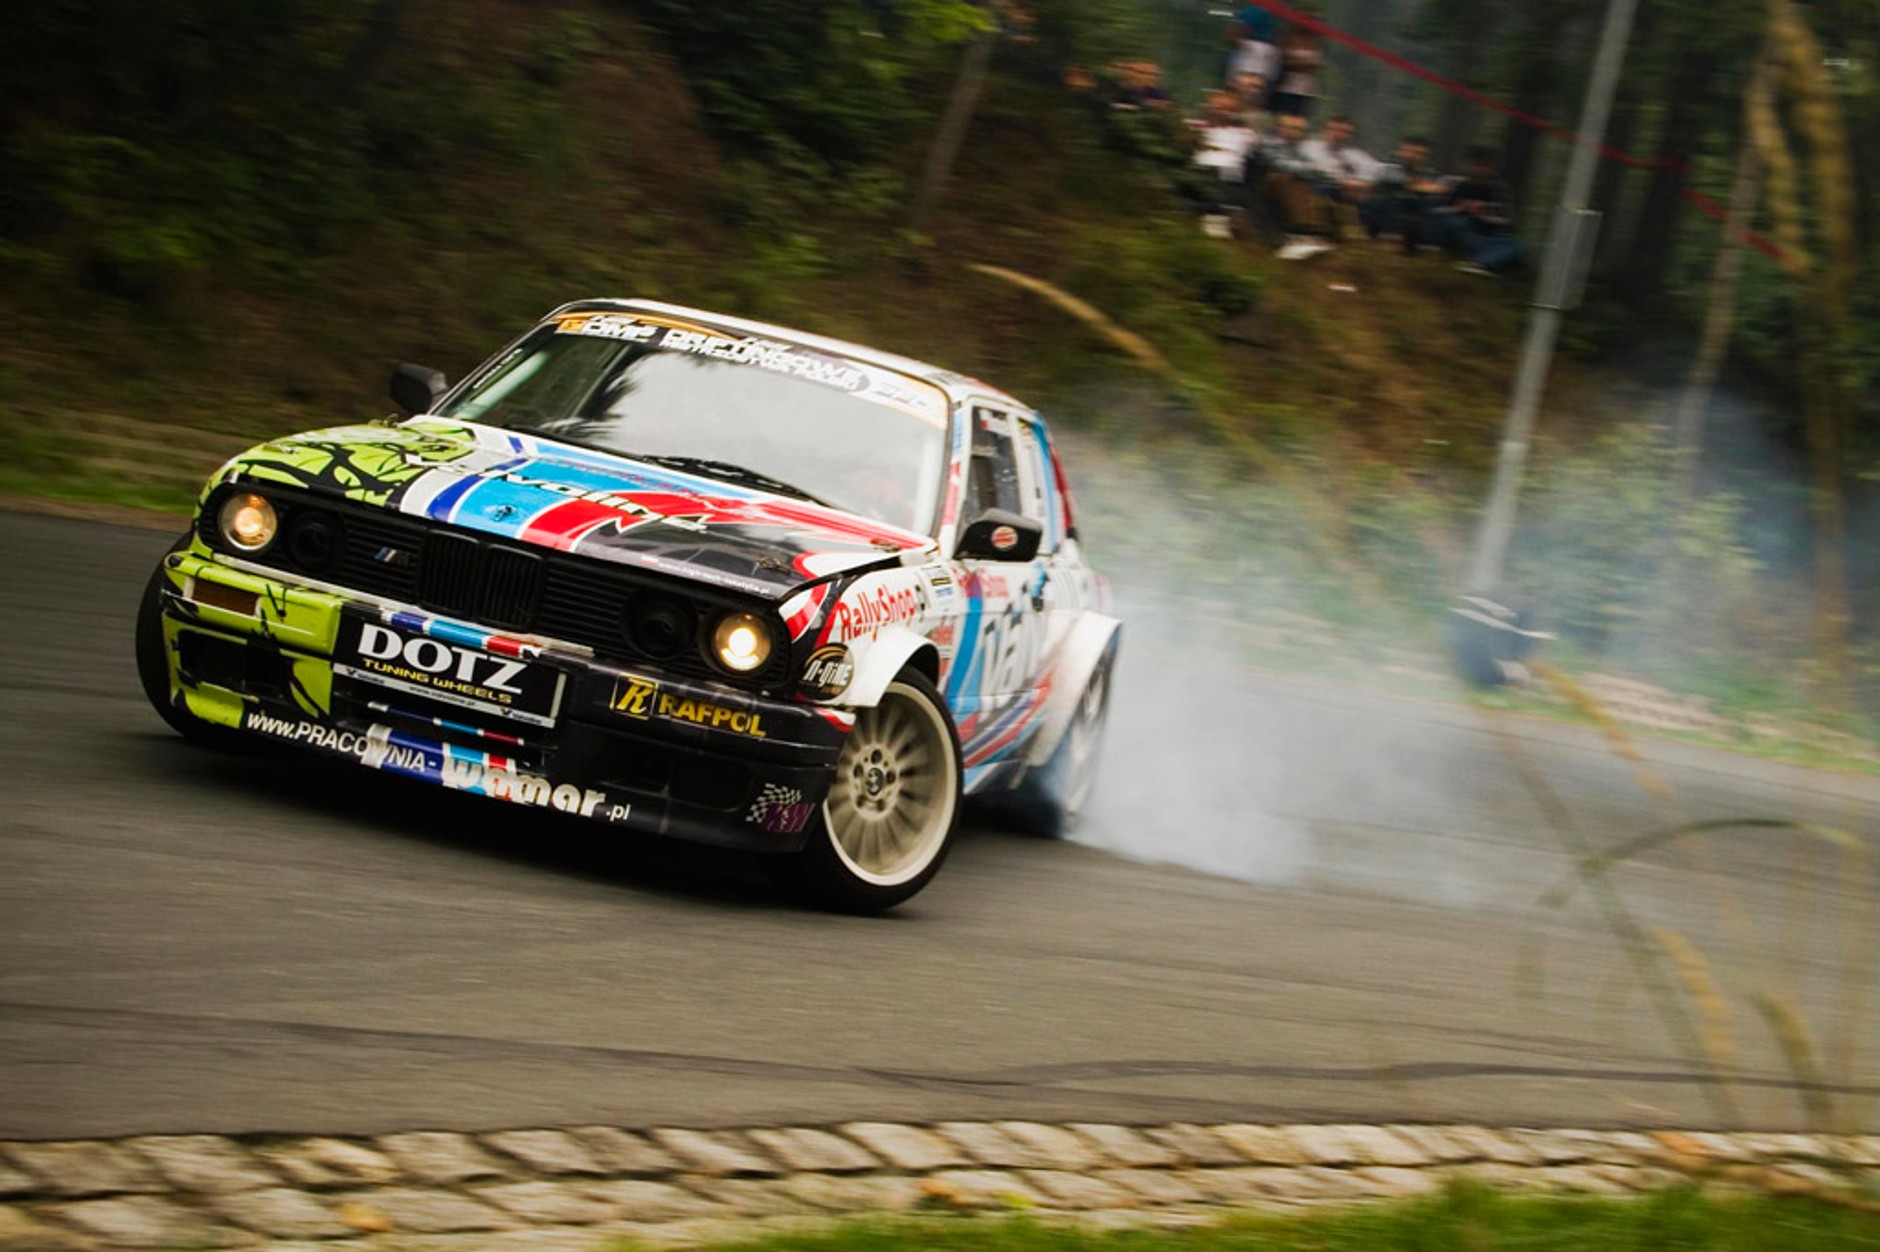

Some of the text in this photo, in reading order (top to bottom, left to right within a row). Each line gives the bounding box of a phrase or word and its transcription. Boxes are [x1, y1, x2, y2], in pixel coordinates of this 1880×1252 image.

[357, 622, 528, 696] DOTZ
[362, 657, 430, 684] TUNING
[432, 676, 513, 704] WHEELS
[658, 692, 768, 738] RAFPOL
